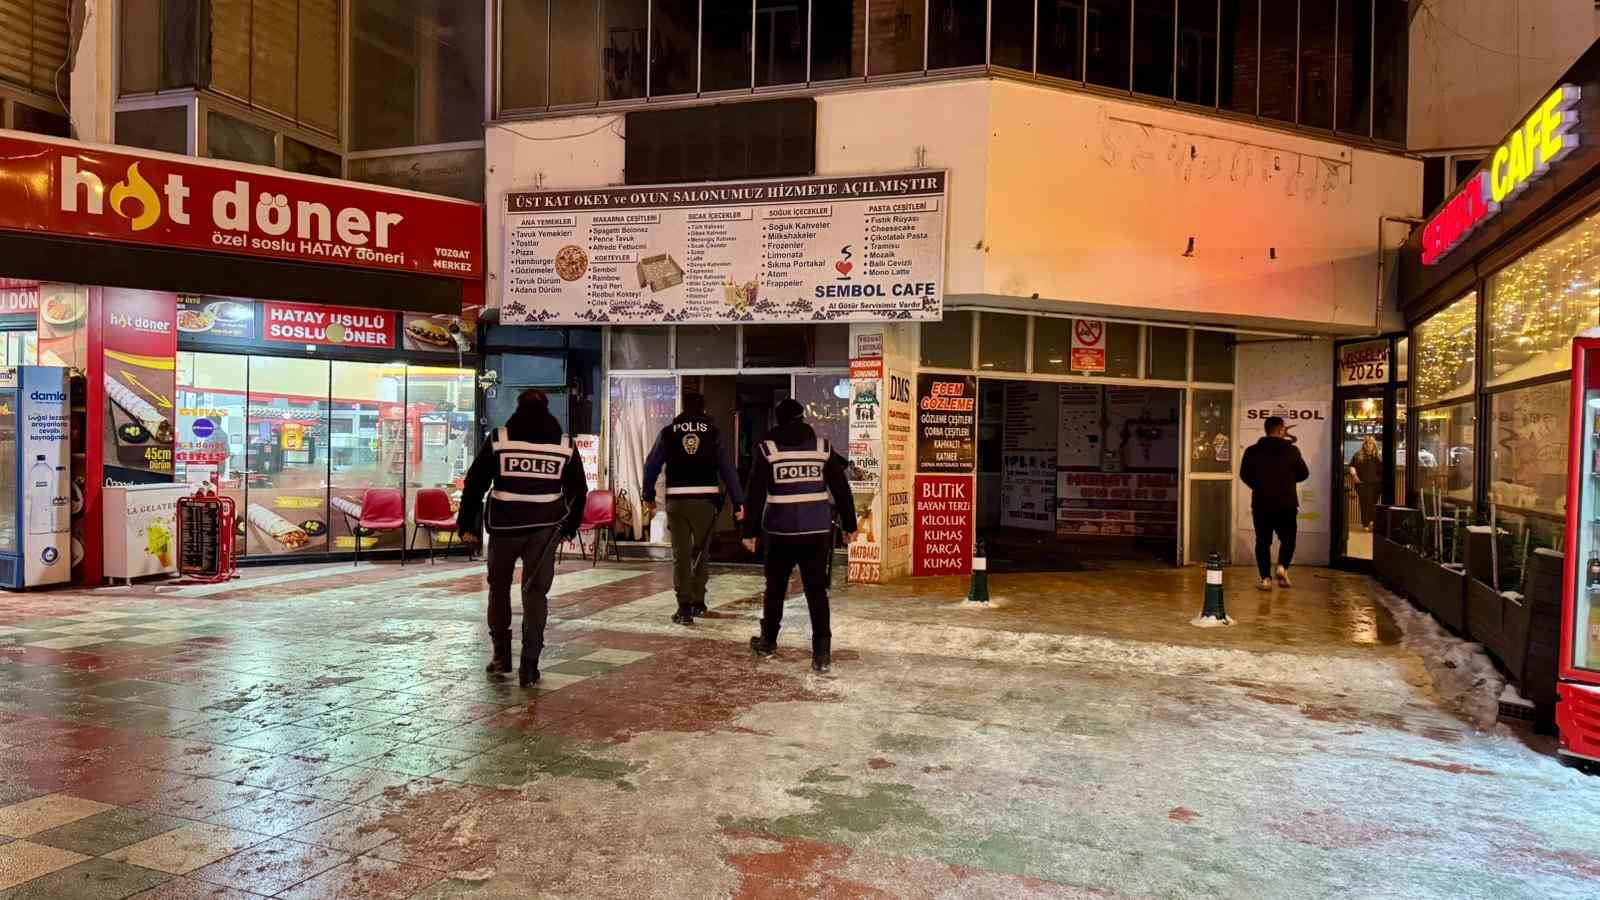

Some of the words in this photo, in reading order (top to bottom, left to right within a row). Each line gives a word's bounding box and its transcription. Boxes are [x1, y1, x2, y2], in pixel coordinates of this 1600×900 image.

[1491, 84, 1570, 203] CAFE
[516, 194, 541, 208] ÜST
[544, 195, 574, 207] KAT
[575, 194, 611, 206] OKEY
[613, 196, 627, 204] ve
[630, 192, 672, 204] OYUN
[673, 188, 763, 202] SALONUMUZ
[767, 182, 838, 198] HİZMETE
[841, 178, 938, 196] AÇILMIŞTIR
[769, 208, 792, 217] SOĞUK
[793, 207, 828, 216] İÇECEKLER
[869, 205, 891, 213] PASTA
[892, 202, 927, 212] ÇEŞİTLERİ
[213, 180, 403, 248] döner
[795, 221, 831, 230] Kahveler
[907, 232, 928, 240] Pasta
[212, 231, 248, 248] özel
[251, 233, 296, 252] soslu
[300, 241, 353, 260] HATAY
[355, 246, 404, 265] döneri
[767, 241, 804, 250] Frozenler
[435, 248, 470, 260] YOZGAT
[433, 260, 472, 272] MERKEZ
[515, 258, 554, 266] Hamburger
[793, 260, 826, 268] Portakal
[515, 267, 554, 275] Gözlemeler
[766, 280, 803, 288] Frappeler
[815, 284, 886, 298] SEMBOL
[892, 283, 935, 296] CAFE
[838, 301, 859, 309] Götür
[271, 308, 325, 324] HATAY
[331, 313, 385, 330] USULÜ
[270, 324, 325, 340] SOSLU
[340, 329, 387, 345] ÖNER
[1348, 363, 1383, 381] 2026
[890, 375, 910, 403] DMS
[30, 391, 67, 401] damla
[921, 395, 974, 411] GÖZLEME
[1247, 409, 1325, 420] SEBOL
[144, 447, 171, 460] 45cm
[917, 501, 945, 511] BAYAN
[922, 513, 967, 526] KİLOLUK
[924, 530, 963, 542] KUMAŞ
[926, 544, 961, 556] PARÇA
[924, 558, 962, 569] KUMAŞ
